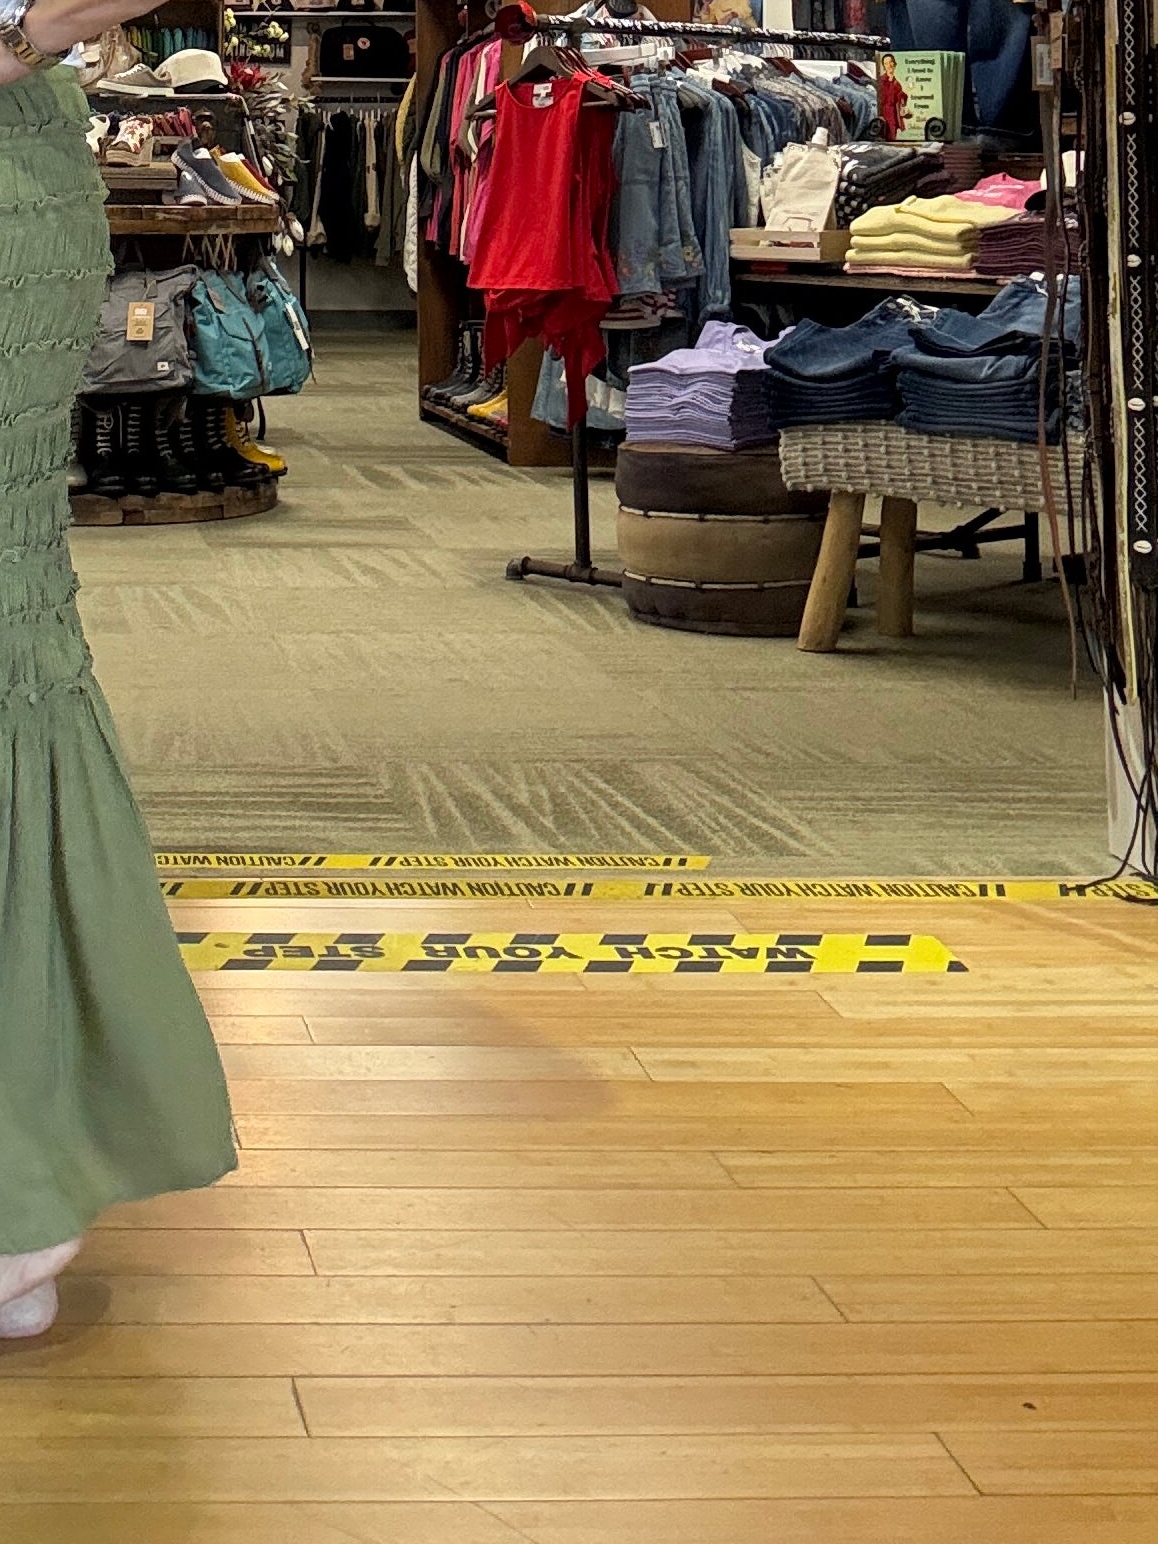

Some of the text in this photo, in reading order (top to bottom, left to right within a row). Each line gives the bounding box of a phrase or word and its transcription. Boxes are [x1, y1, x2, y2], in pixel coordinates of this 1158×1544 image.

[157, 855, 296, 866] CAUTION WATC
[399, 856, 661, 867] CAUTION WATCH YOUR STEP
[264, 882, 562, 897] CAUTION WATCH YOUR STEP
[676, 882, 978, 897] CAUTION WATCH YOUR STEP
[242, 945, 818, 960] WATCH YOUR STEP
